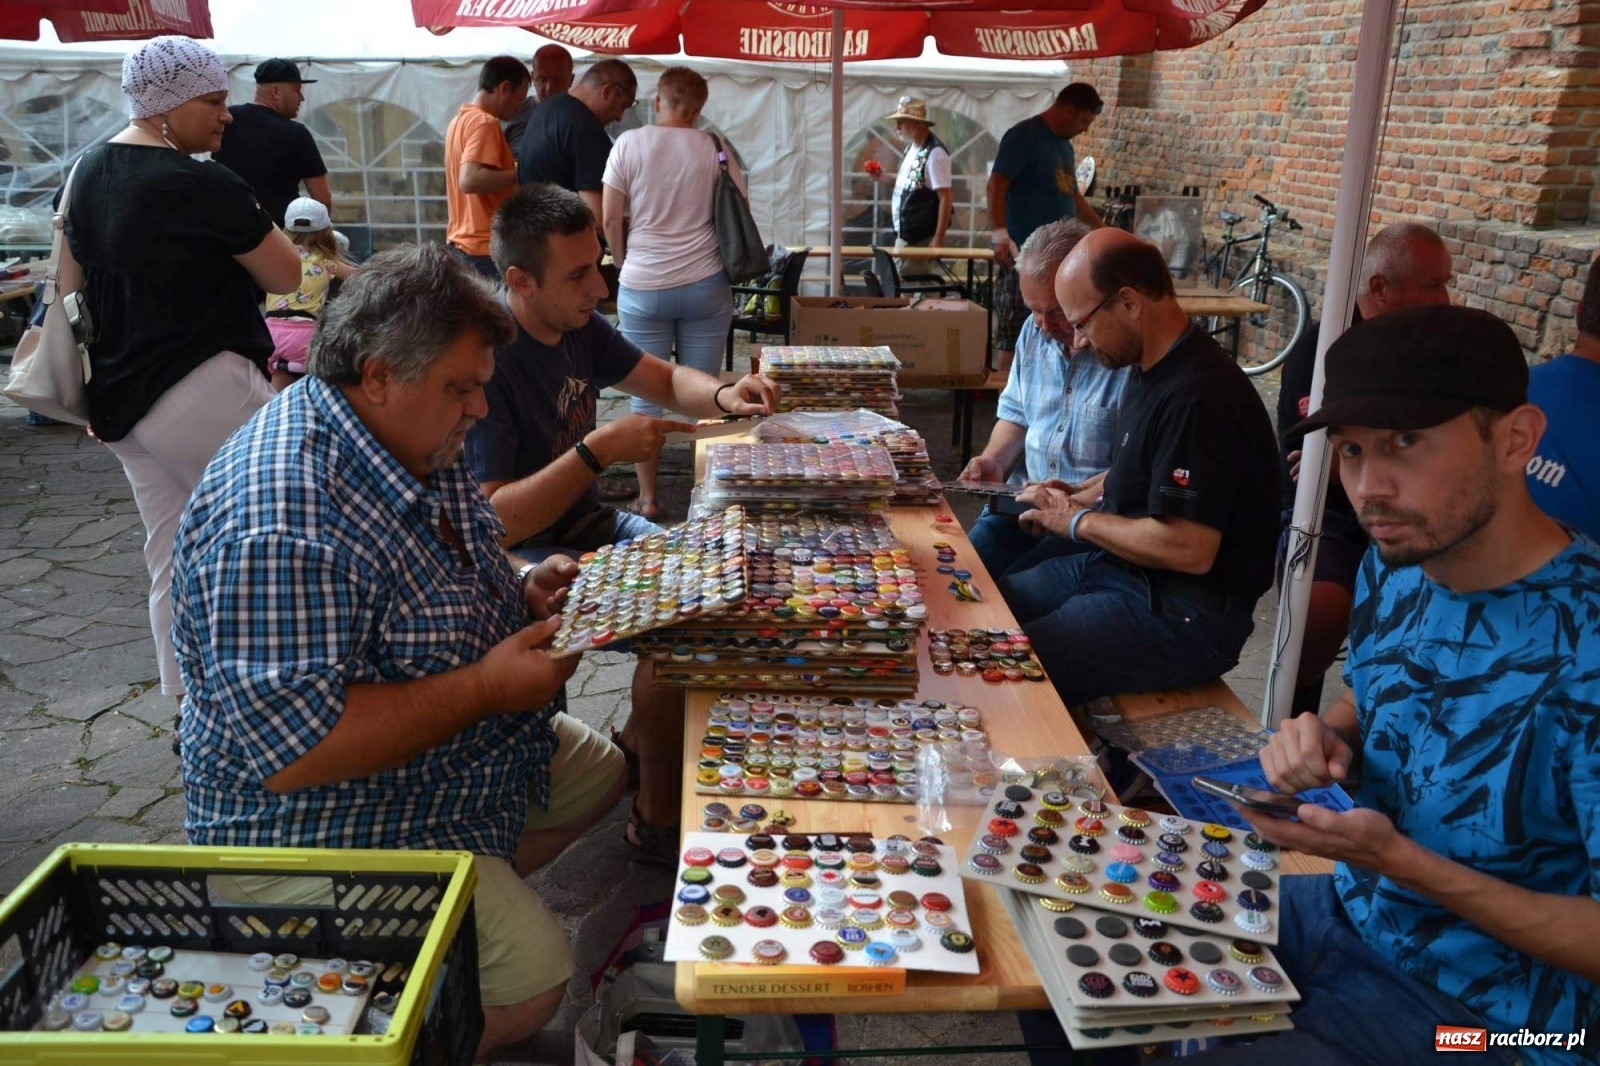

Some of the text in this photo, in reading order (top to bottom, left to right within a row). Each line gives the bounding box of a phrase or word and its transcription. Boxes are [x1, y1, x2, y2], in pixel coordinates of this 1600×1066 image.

[1525, 455, 1566, 487] om
[711, 982, 893, 995] TENDER DESSERT ROSHEN
